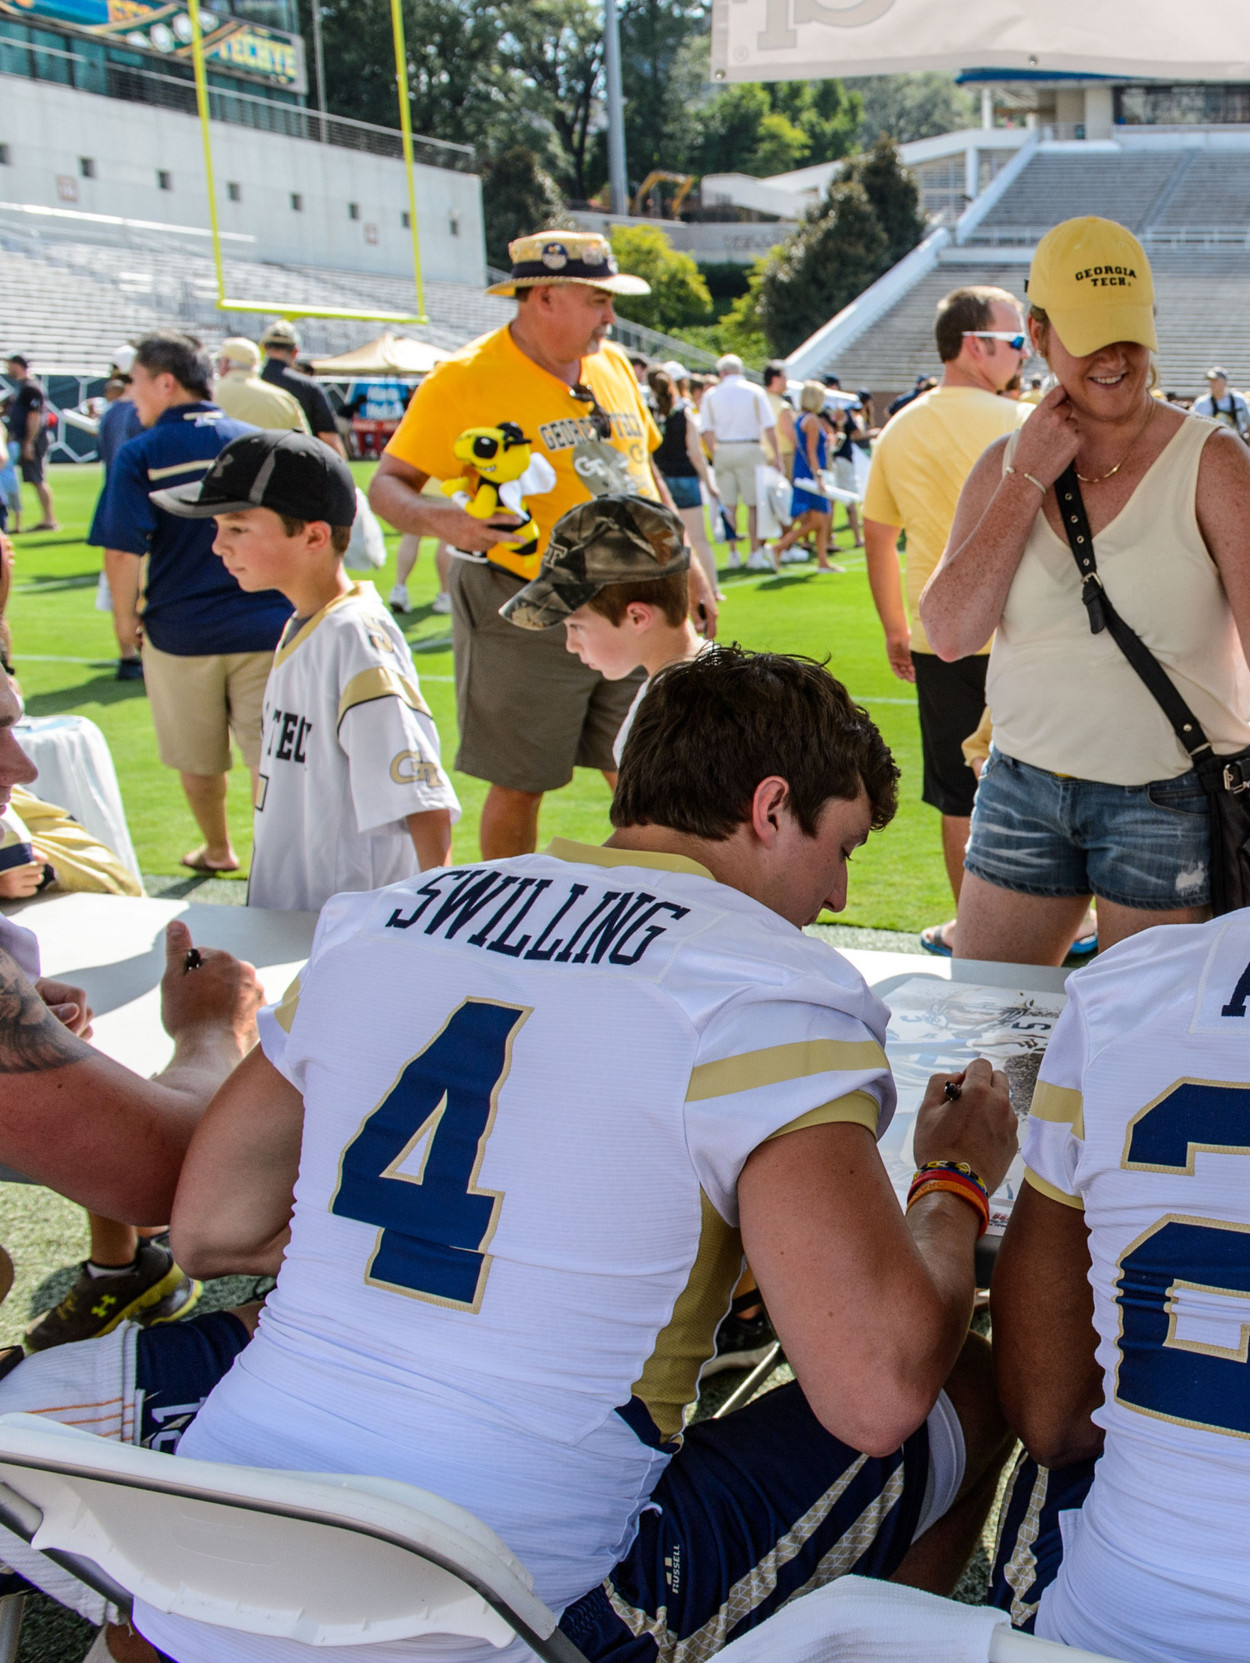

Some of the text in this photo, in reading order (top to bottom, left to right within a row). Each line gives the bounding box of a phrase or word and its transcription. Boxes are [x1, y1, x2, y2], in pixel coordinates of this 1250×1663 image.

[1075, 266, 1136, 281] GEORGIA
[384, 869, 691, 966] SWILLING
[327, 995, 535, 1315] 4
[672, 1544, 680, 1594] RUSSELL
